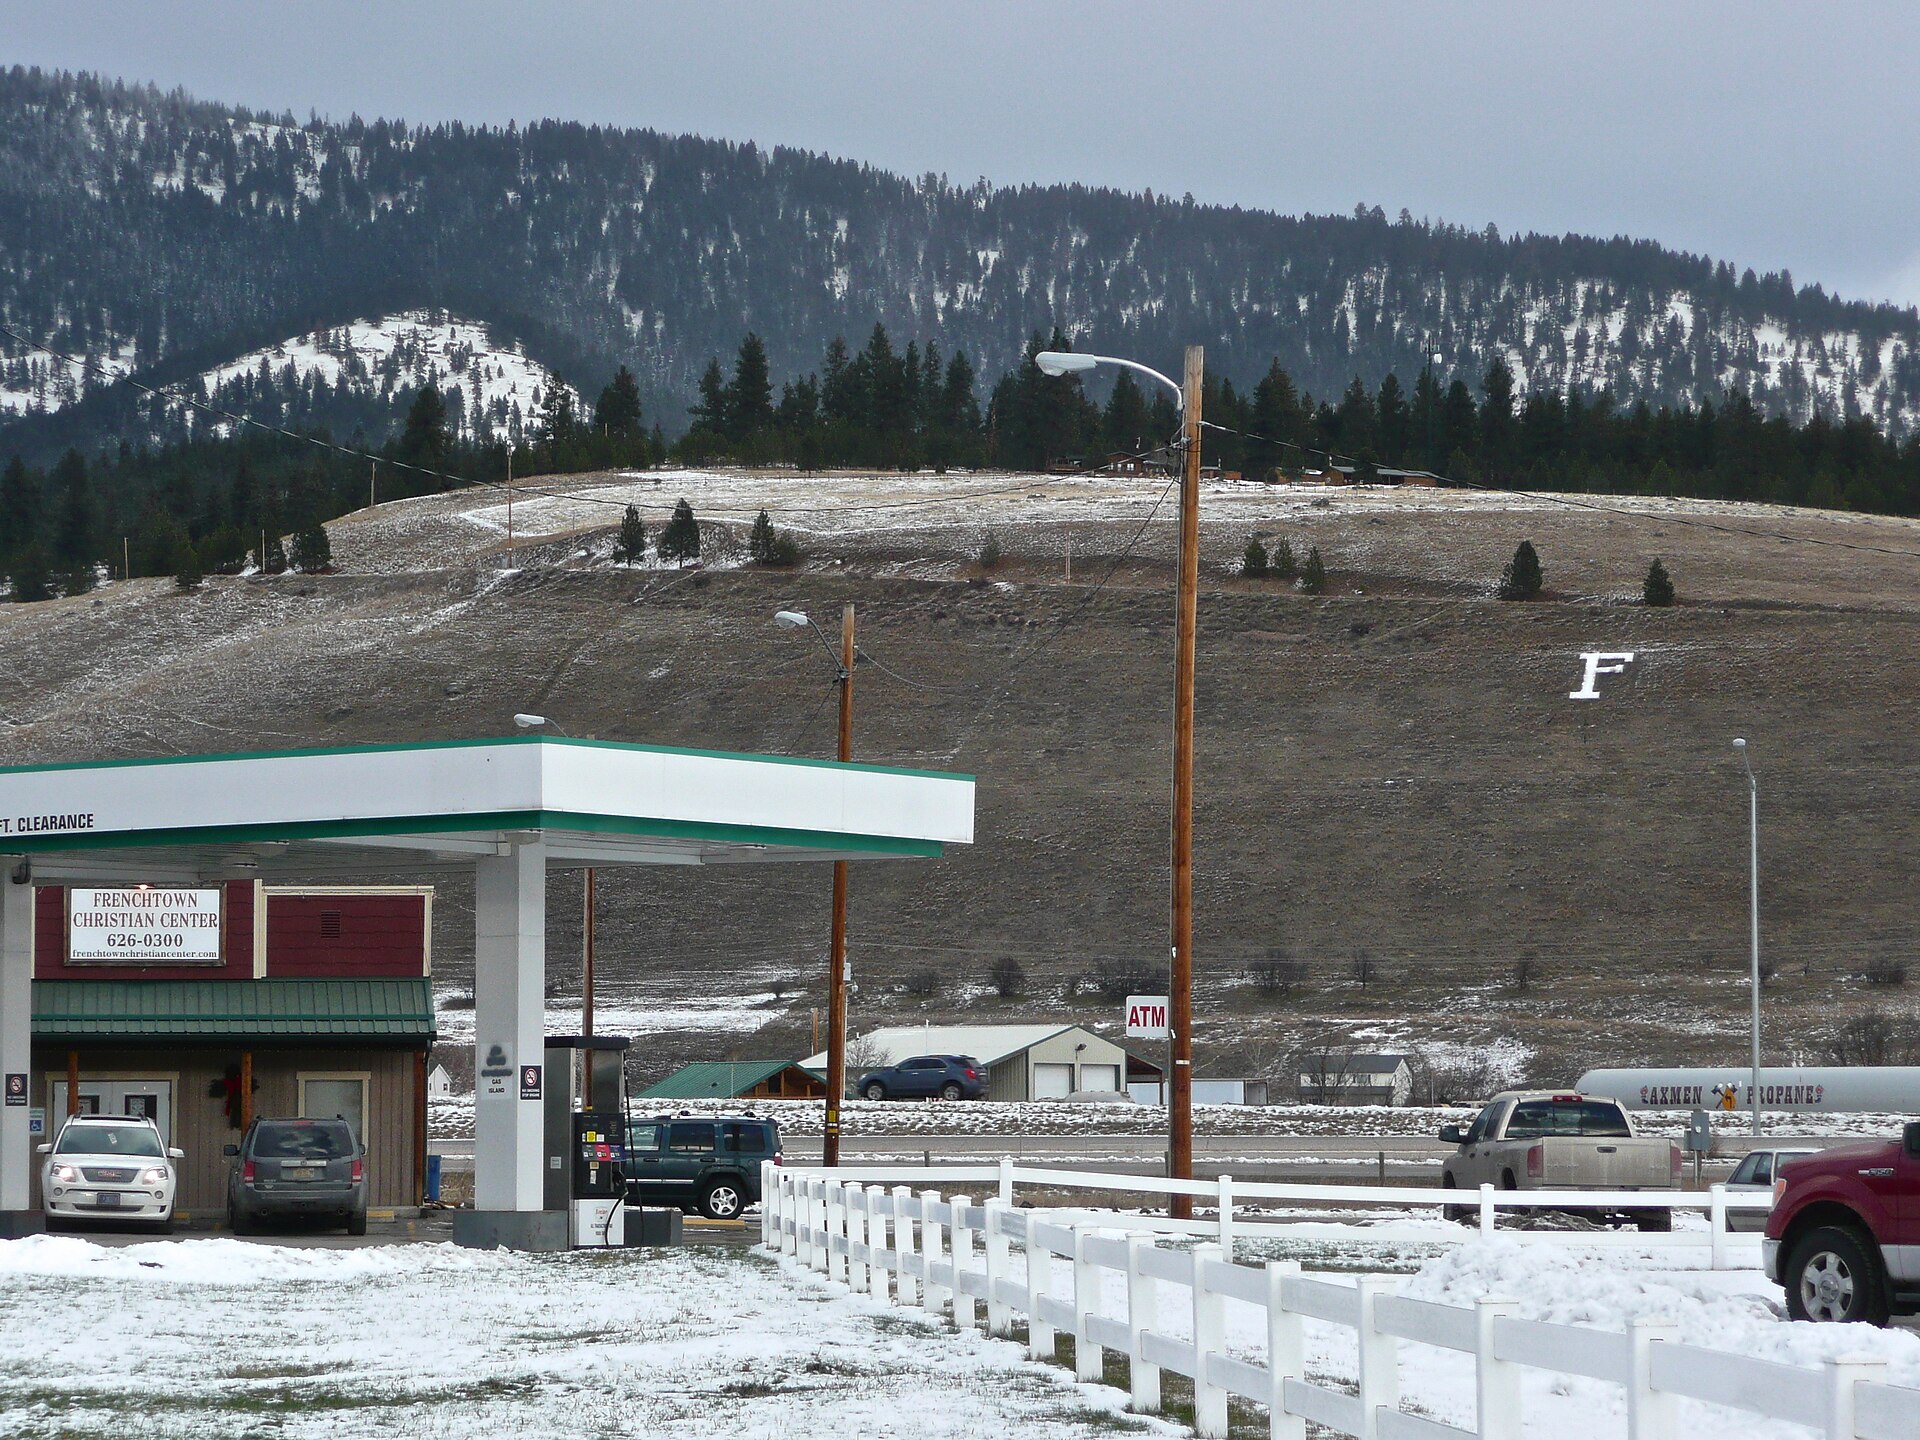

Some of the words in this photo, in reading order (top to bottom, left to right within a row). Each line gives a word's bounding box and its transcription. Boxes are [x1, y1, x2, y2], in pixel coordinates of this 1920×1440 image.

[1569, 651, 1634, 699] F
[18, 813, 94, 832] CLEARANCE
[93, 892, 197, 908] FRENCHTOWN
[73, 912, 155, 928] CHRISTIAN
[160, 912, 218, 928] CENTER
[107, 933, 183, 947] 626-0300
[72, 949, 217, 958] frenchtownchristiancenter.com
[1128, 1006, 1165, 1027] ATM
[1649, 1085, 1703, 1105] AXMEN
[1746, 1085, 1814, 1105] PROPANE
